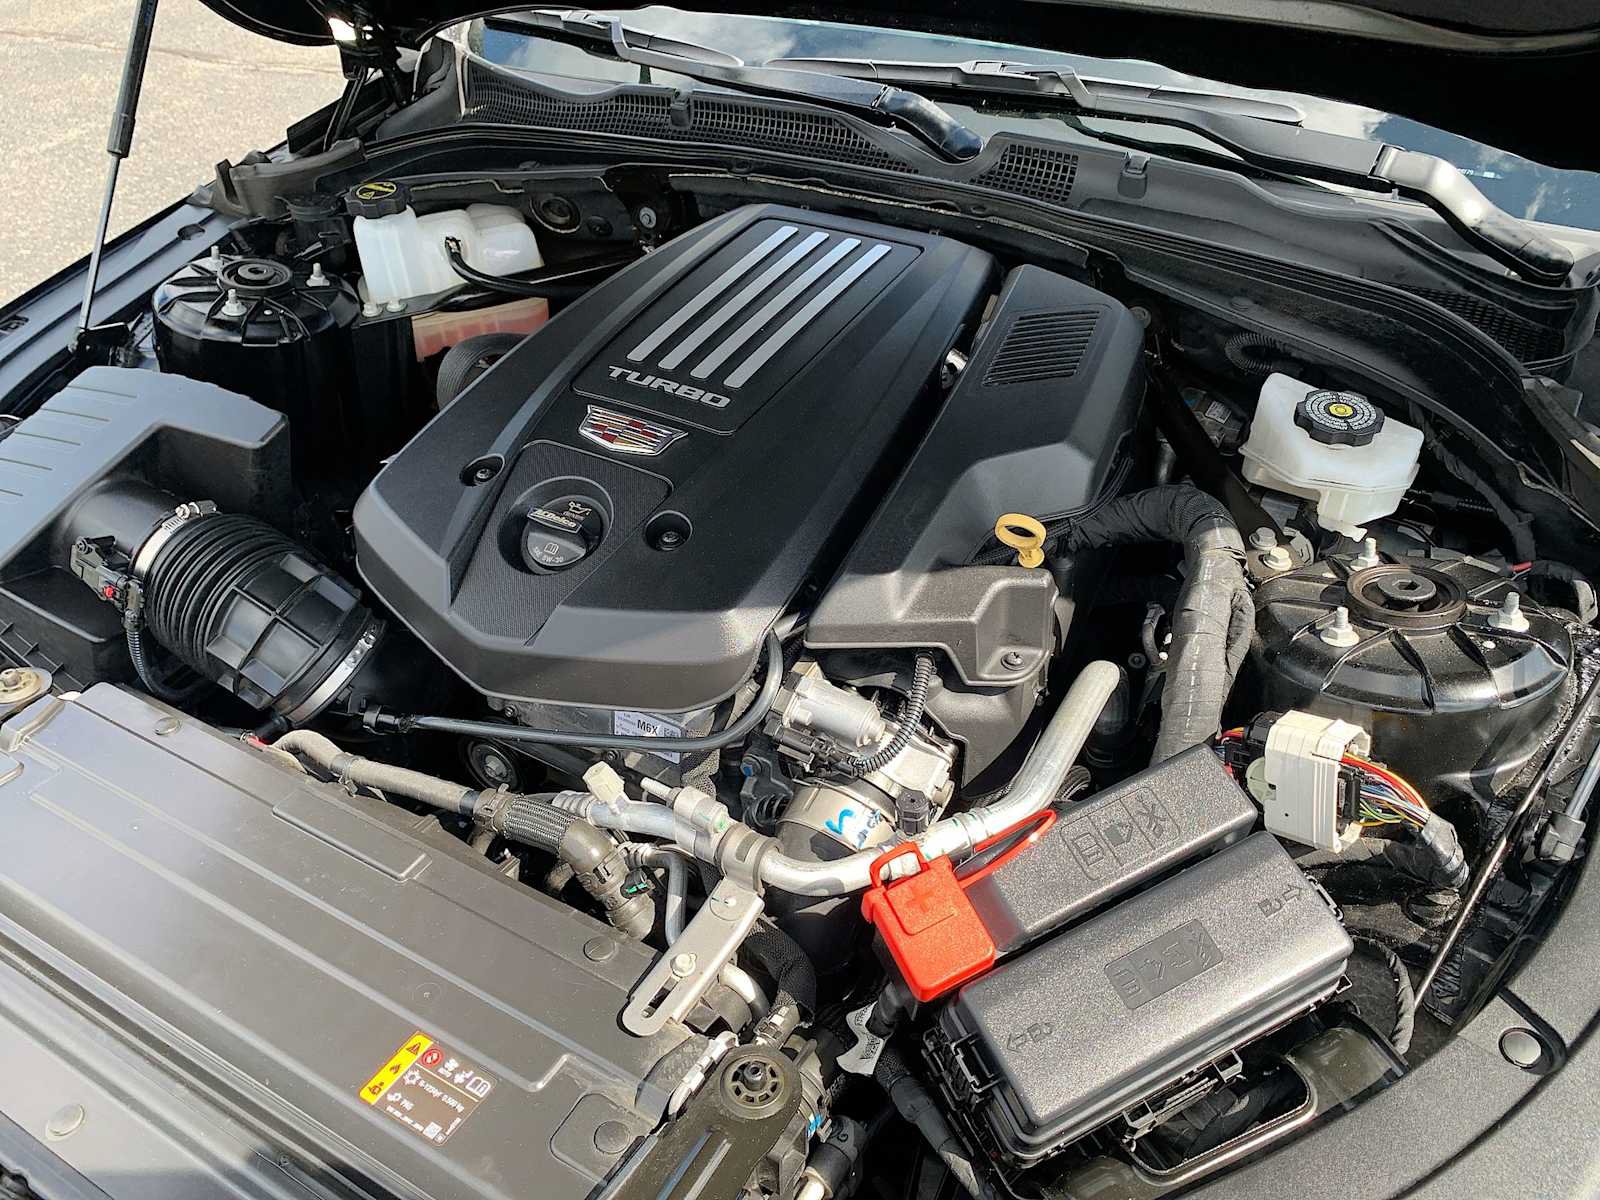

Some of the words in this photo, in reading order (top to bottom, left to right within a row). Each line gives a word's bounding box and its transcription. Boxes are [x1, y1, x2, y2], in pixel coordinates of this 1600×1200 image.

[609, 366, 730, 408] TURBO
[530, 508, 577, 528] ACDelco
[637, 719, 658, 736] M6X
